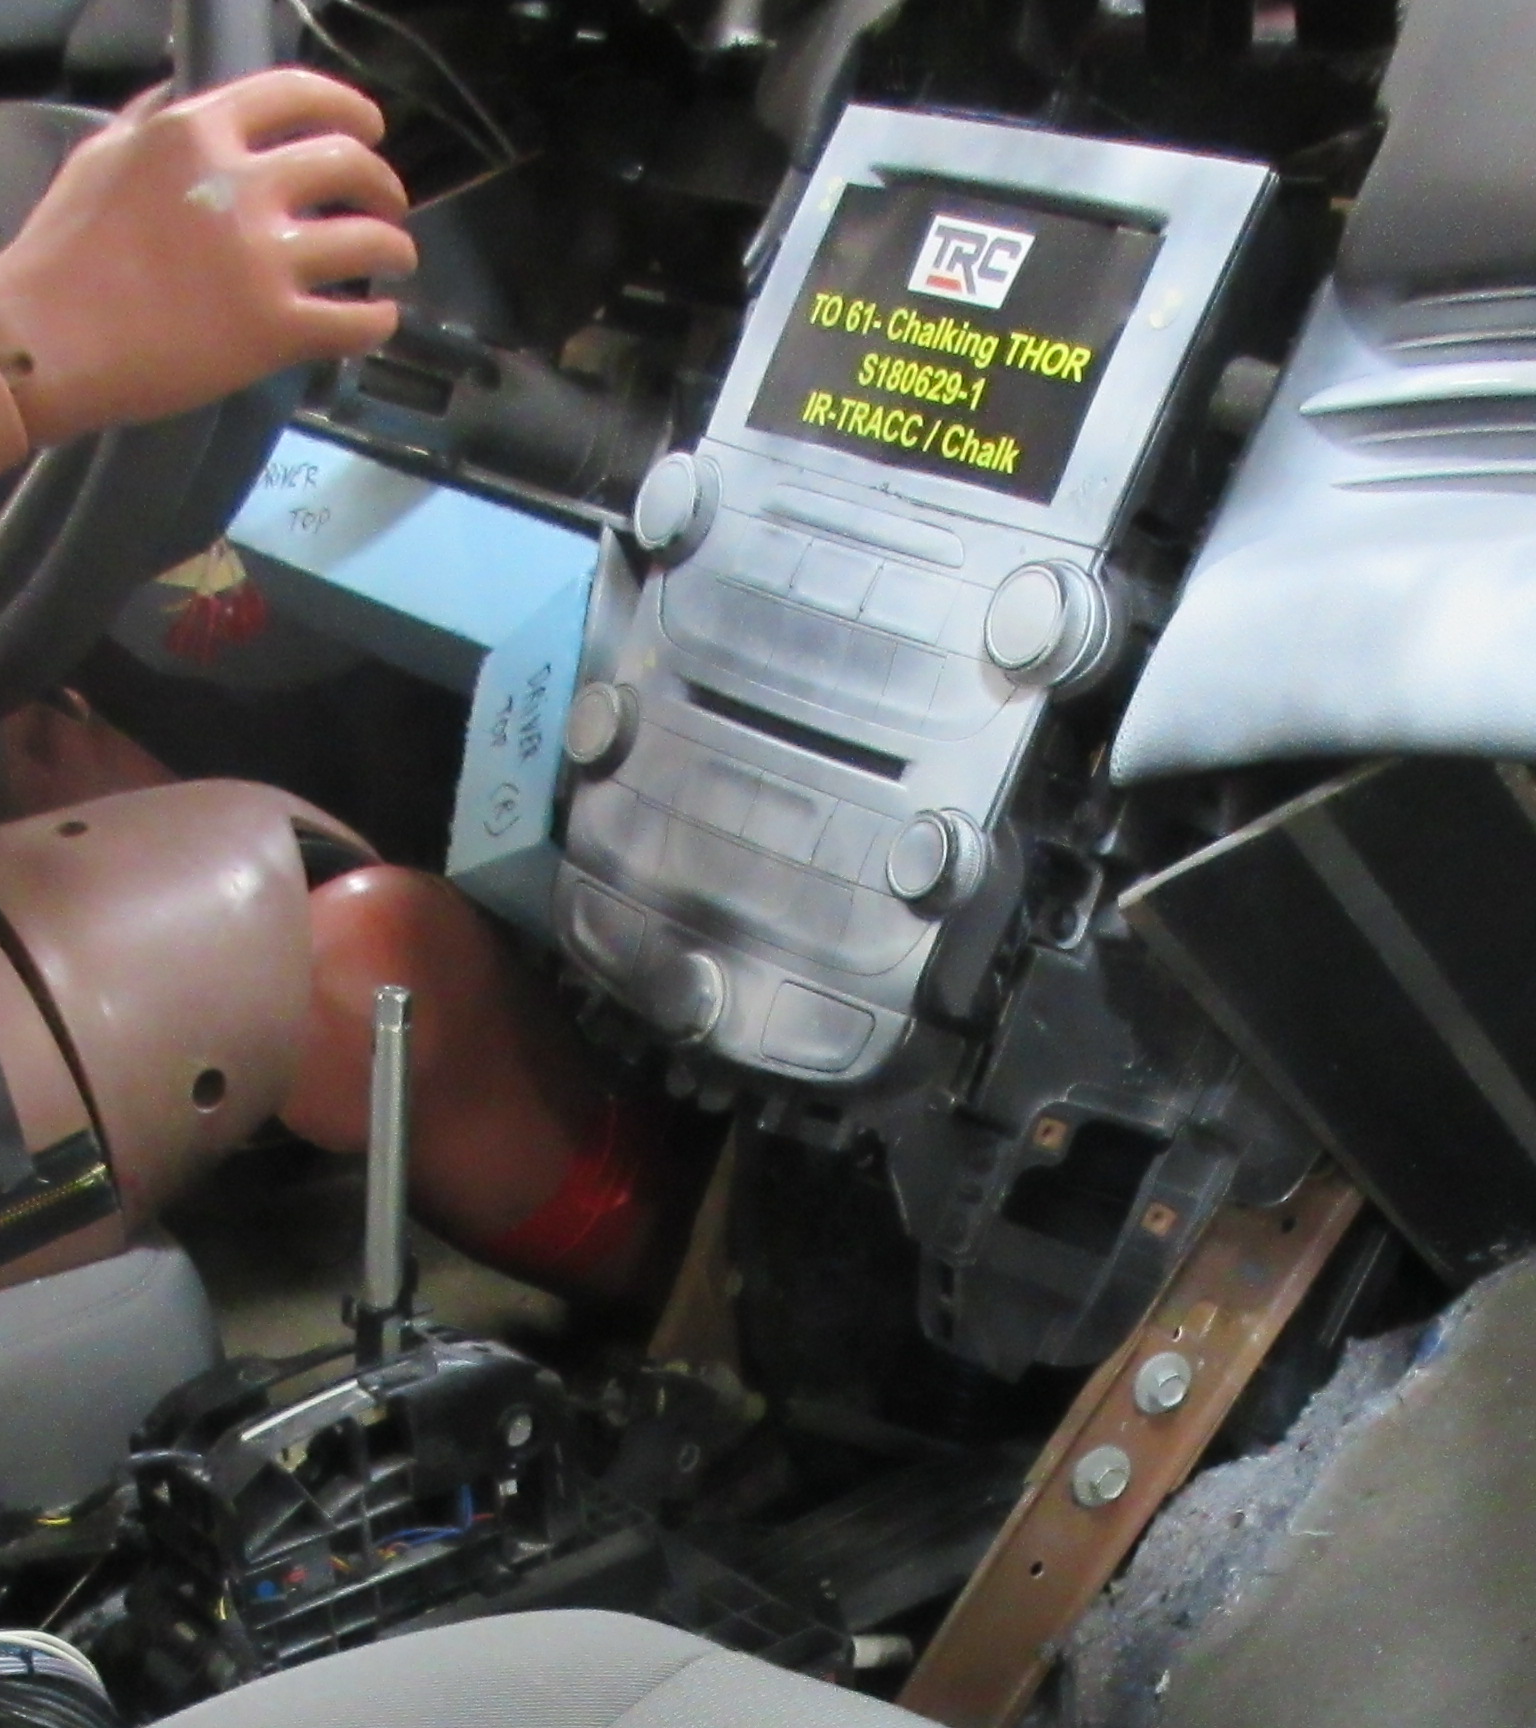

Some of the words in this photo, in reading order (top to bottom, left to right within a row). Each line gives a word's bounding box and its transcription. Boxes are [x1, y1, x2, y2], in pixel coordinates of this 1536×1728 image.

[933, 224, 1023, 296] TRC
[809, 293, 843, 328] TO
[845, 300, 881, 335] 61-
[887, 308, 1000, 369] Chalking
[1005, 331, 1092, 383] THOR
[858, 352, 986, 411] S180629-1
[802, 391, 924, 448] IR-TRACC
[922, 419, 942, 452] /
[942, 424, 1021, 474] Chalk
